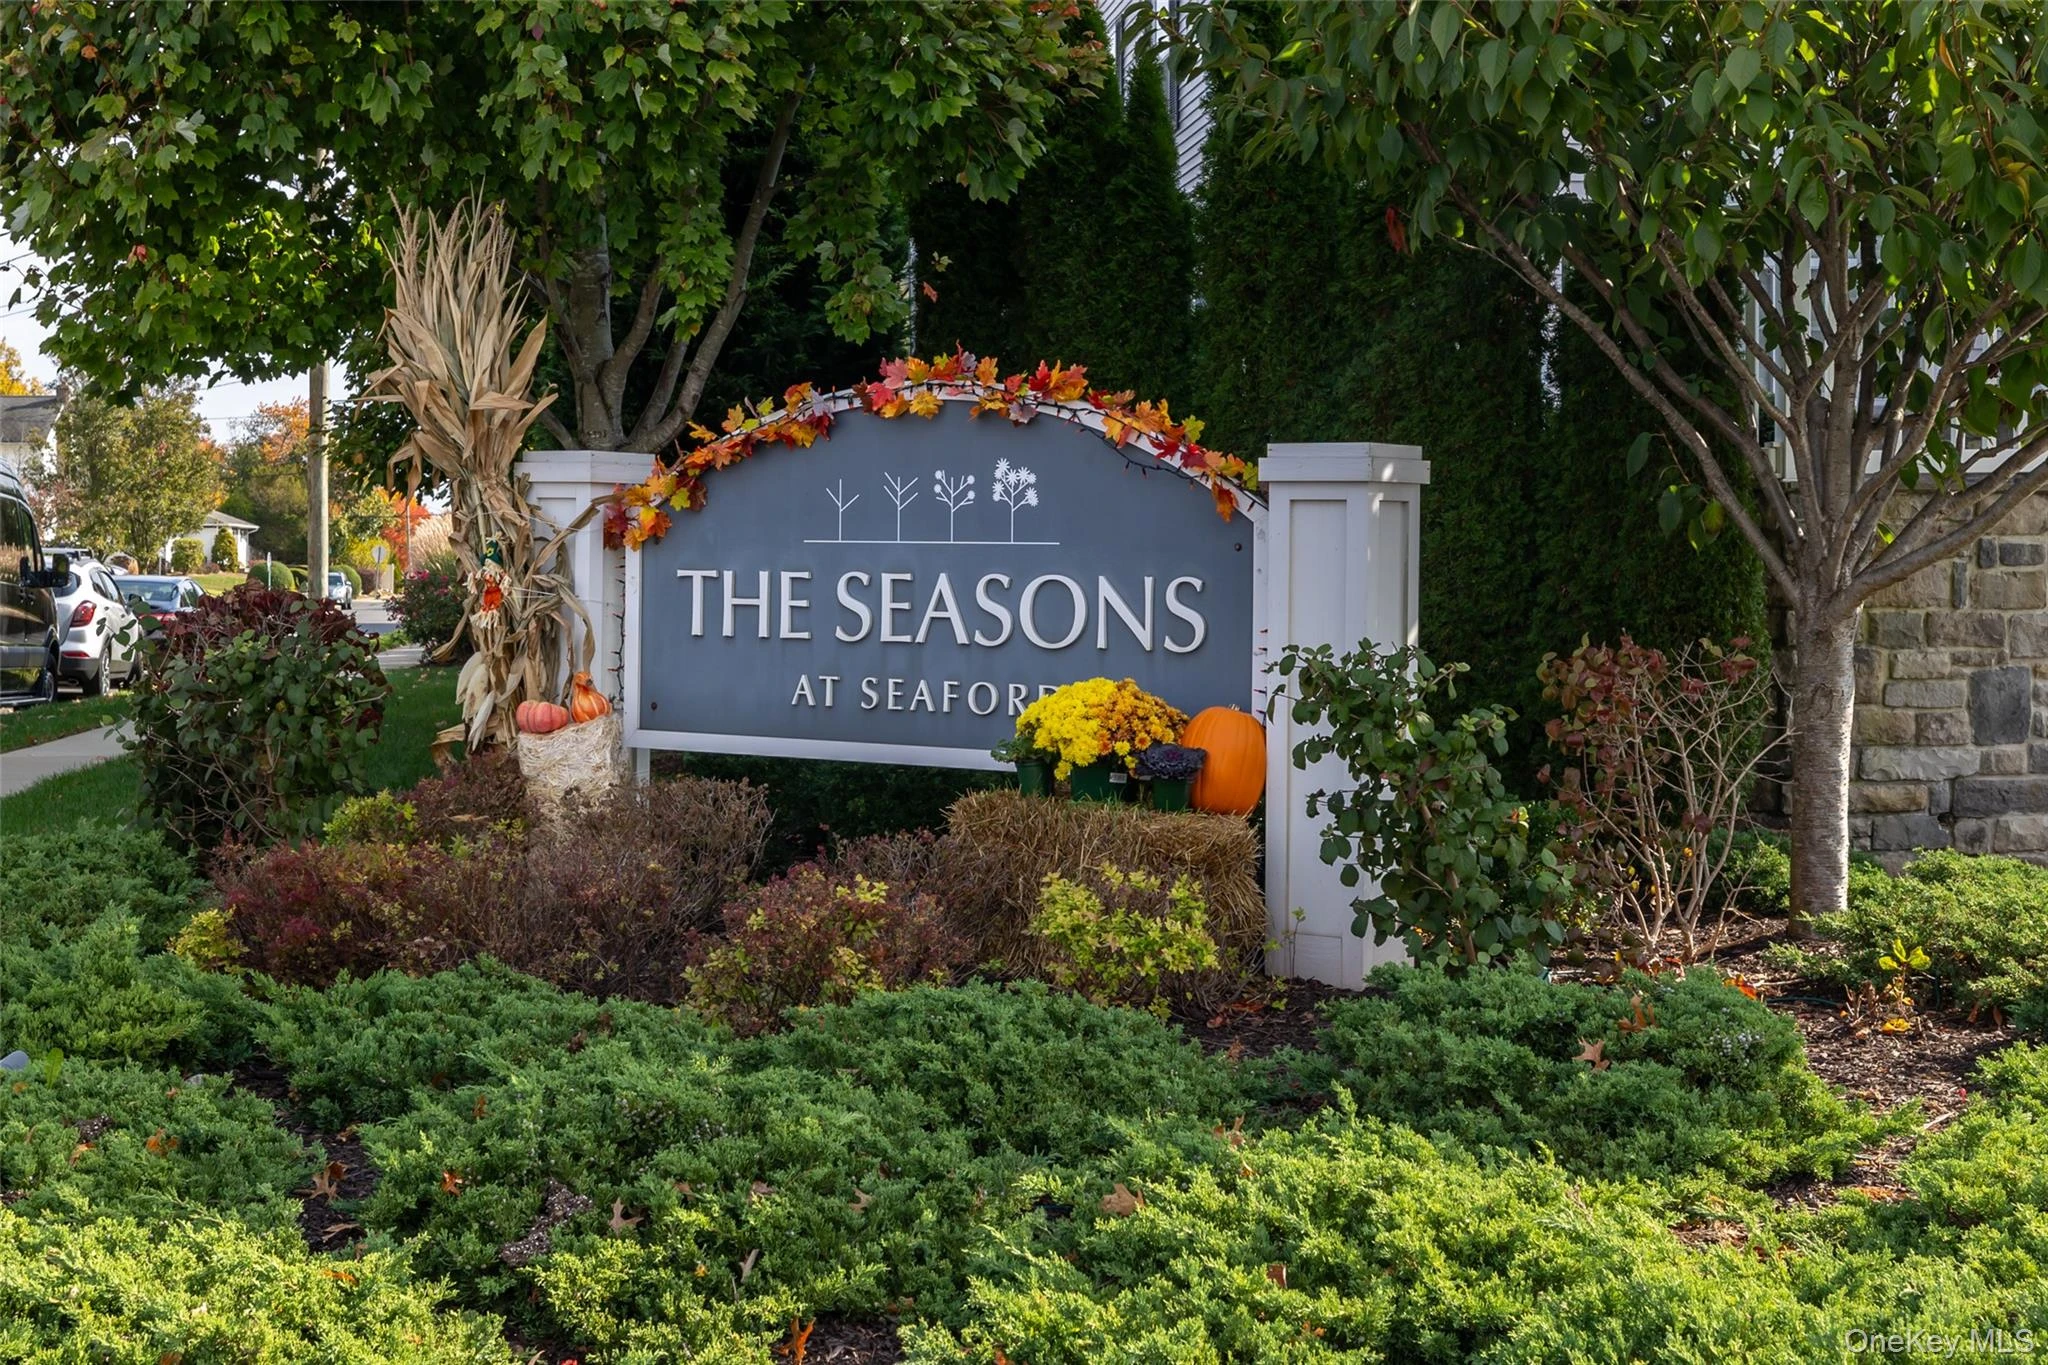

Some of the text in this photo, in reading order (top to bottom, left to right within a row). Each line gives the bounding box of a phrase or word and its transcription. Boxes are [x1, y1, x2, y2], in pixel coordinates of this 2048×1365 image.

[677, 569, 1206, 653] THE SEASONS
[791, 674, 840, 707] AT
